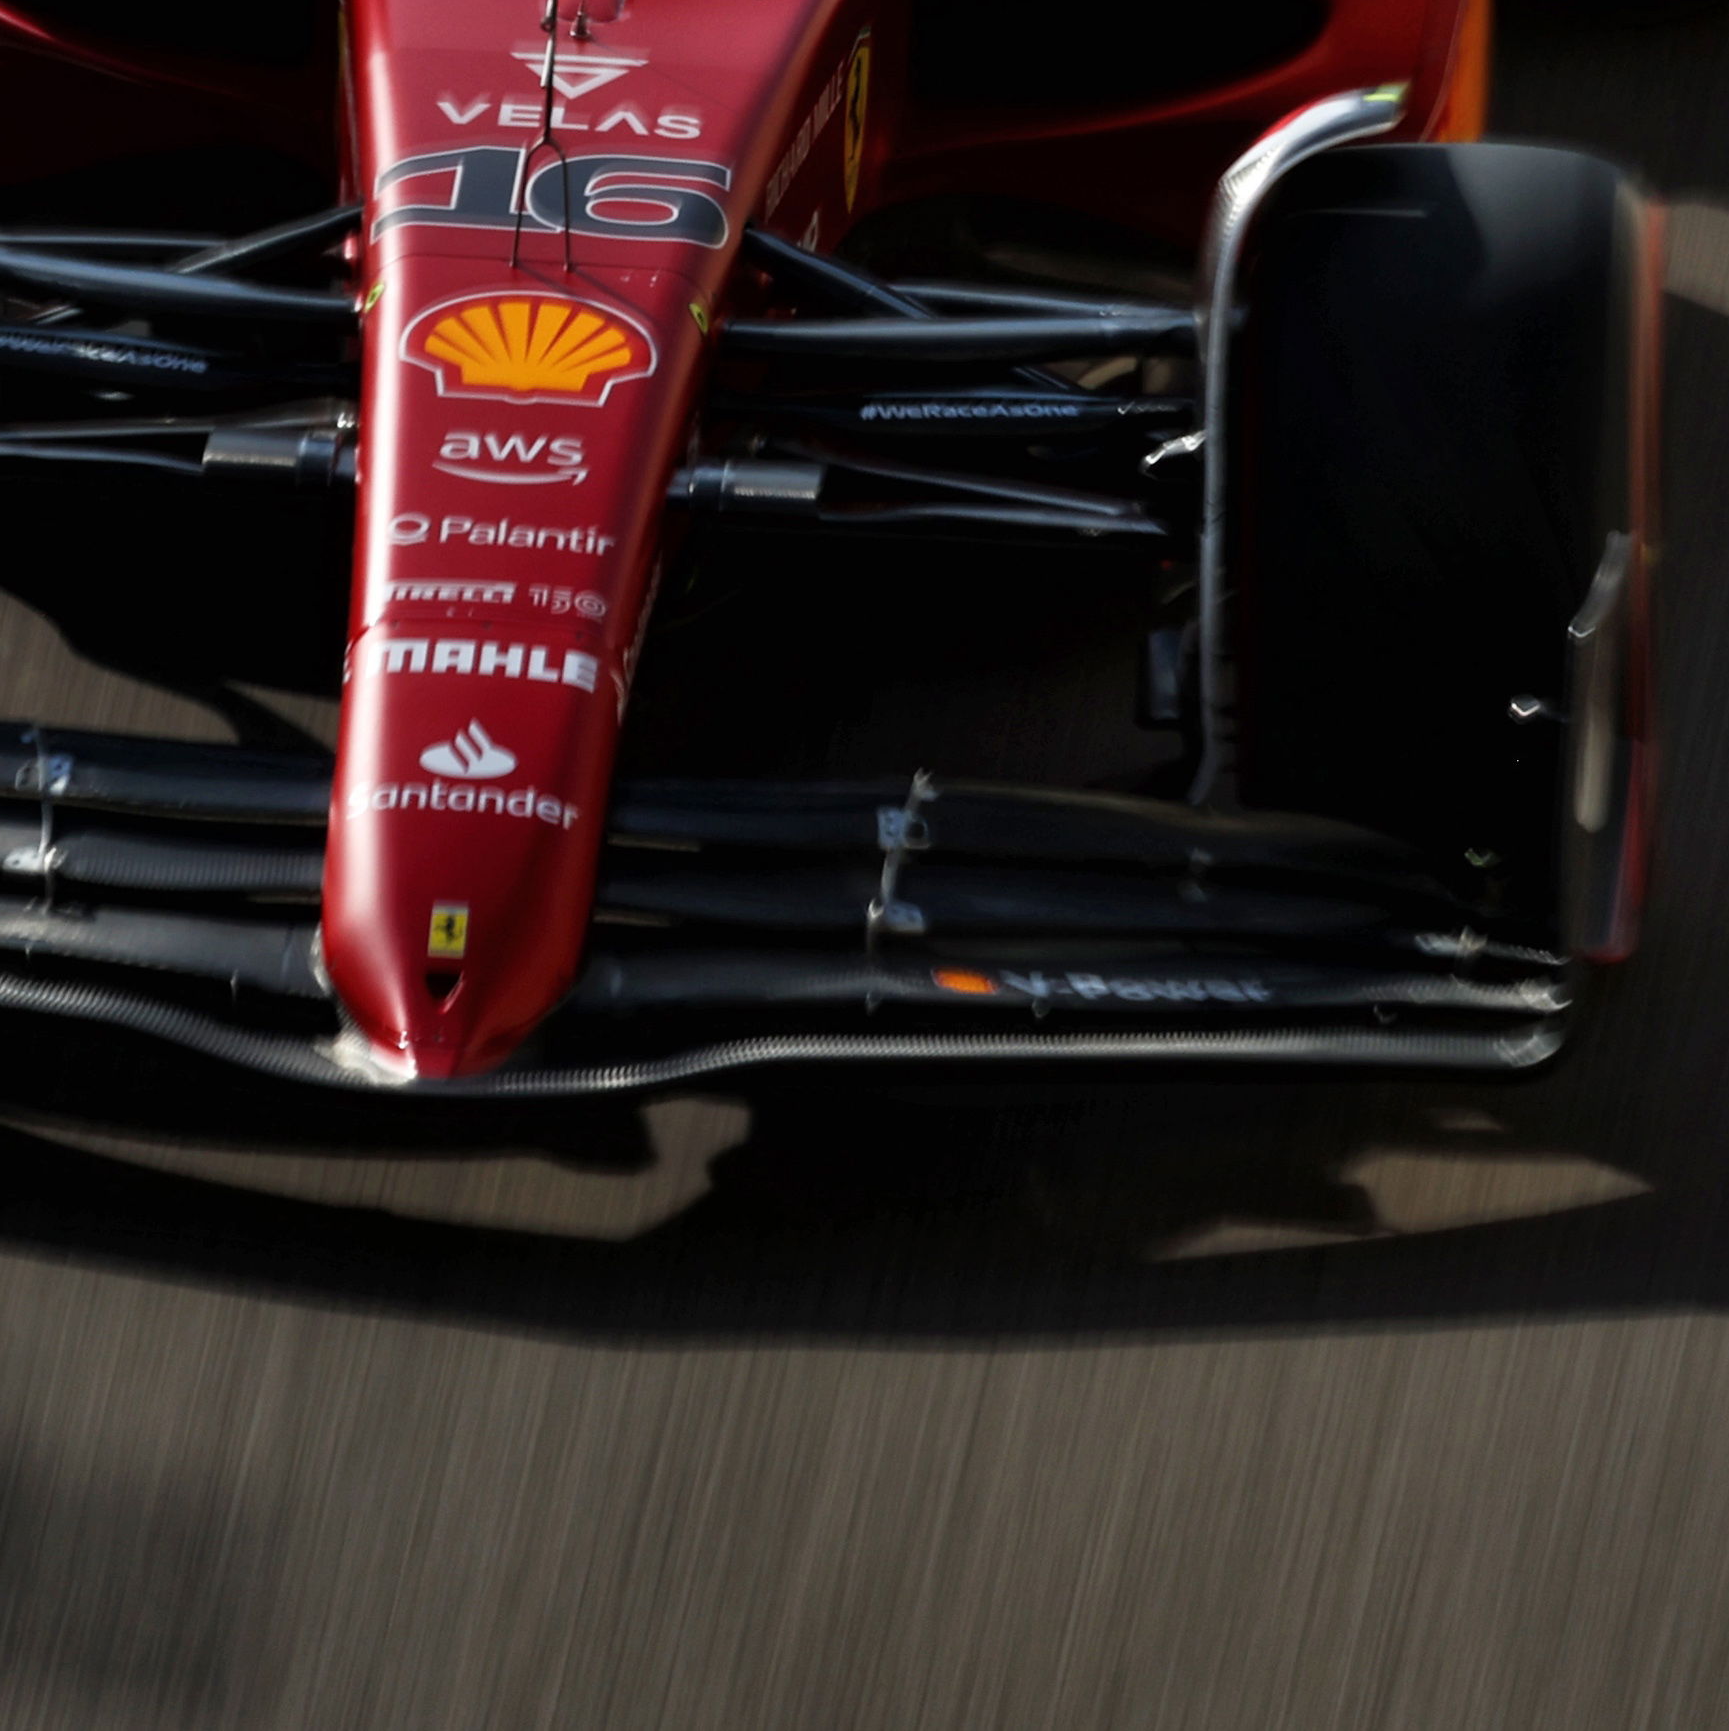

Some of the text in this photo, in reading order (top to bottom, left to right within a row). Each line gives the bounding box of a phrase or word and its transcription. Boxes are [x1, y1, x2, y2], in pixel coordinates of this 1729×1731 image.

[436, 100, 701, 139] VELAS
[370, 145, 731, 249] 16
[859, 401, 1082, 422] #WeRaceAsOne
[439, 431, 584, 466] aws
[438, 515, 616, 557] Palantir
[365, 640, 599, 694] MAHLE
